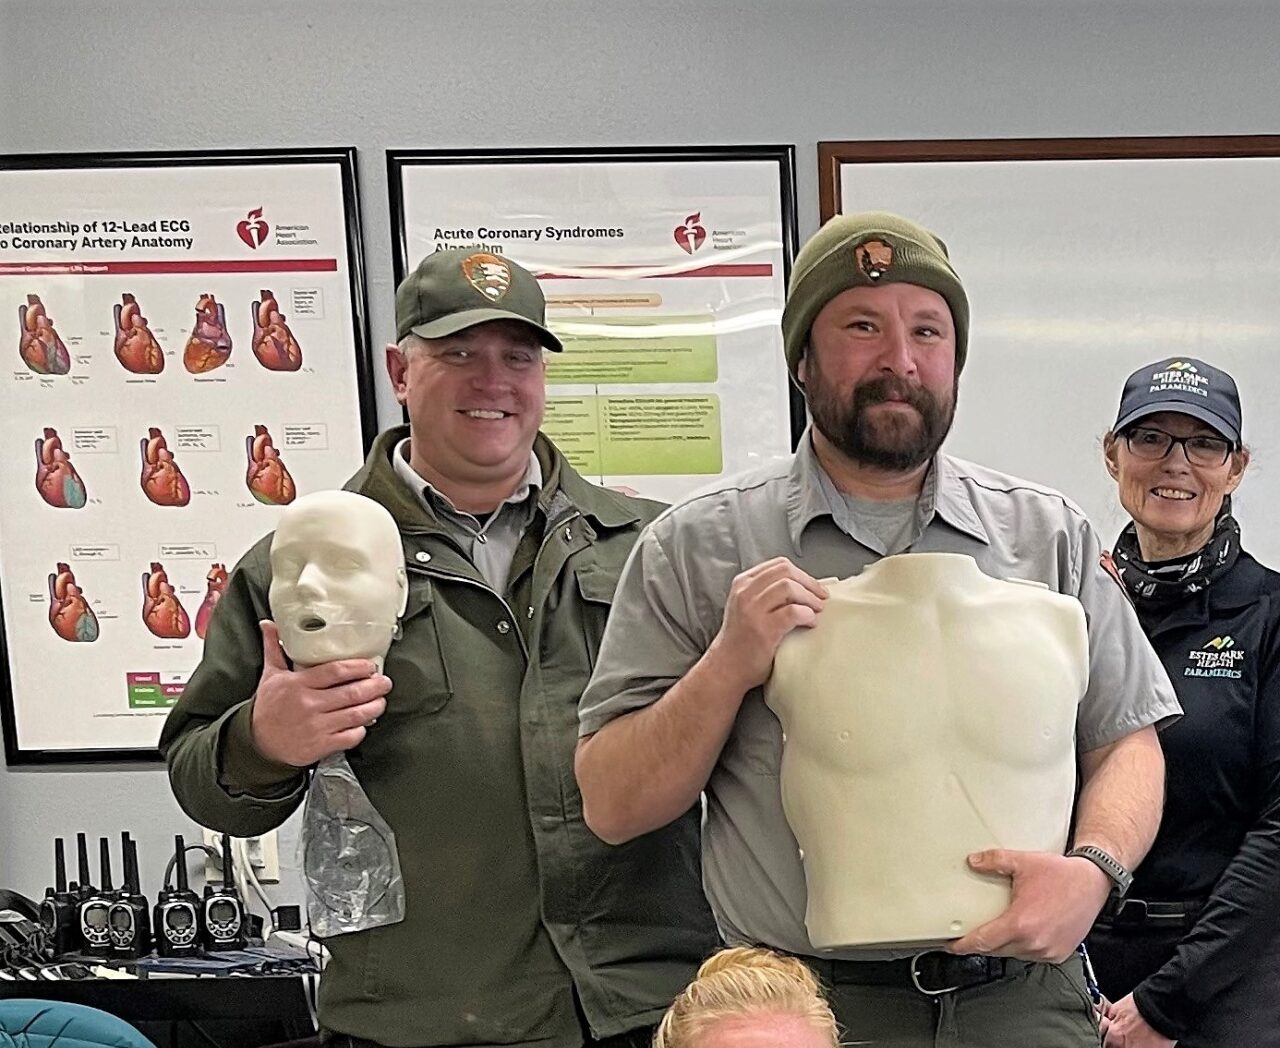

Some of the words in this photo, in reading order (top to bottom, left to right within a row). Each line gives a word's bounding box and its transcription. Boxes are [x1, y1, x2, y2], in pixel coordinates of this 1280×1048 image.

[0, 222, 79, 235] elationship
[83, 221, 97, 233] of
[102, 221, 157, 233] 12-Lead
[160, 220, 190, 232] ECG
[433, 228, 474, 240] Acute
[477, 227, 542, 240] Coronary
[545, 226, 624, 240] Syndromes
[12, 238, 77, 250] Coronary
[82, 237, 127, 250] Artery
[131, 236, 193, 249] Anatomy
[1189, 650, 1219, 660] ESTES
[1220, 650, 1244, 660] PARK
[1184, 667, 1242, 679] PARAMEDICS
